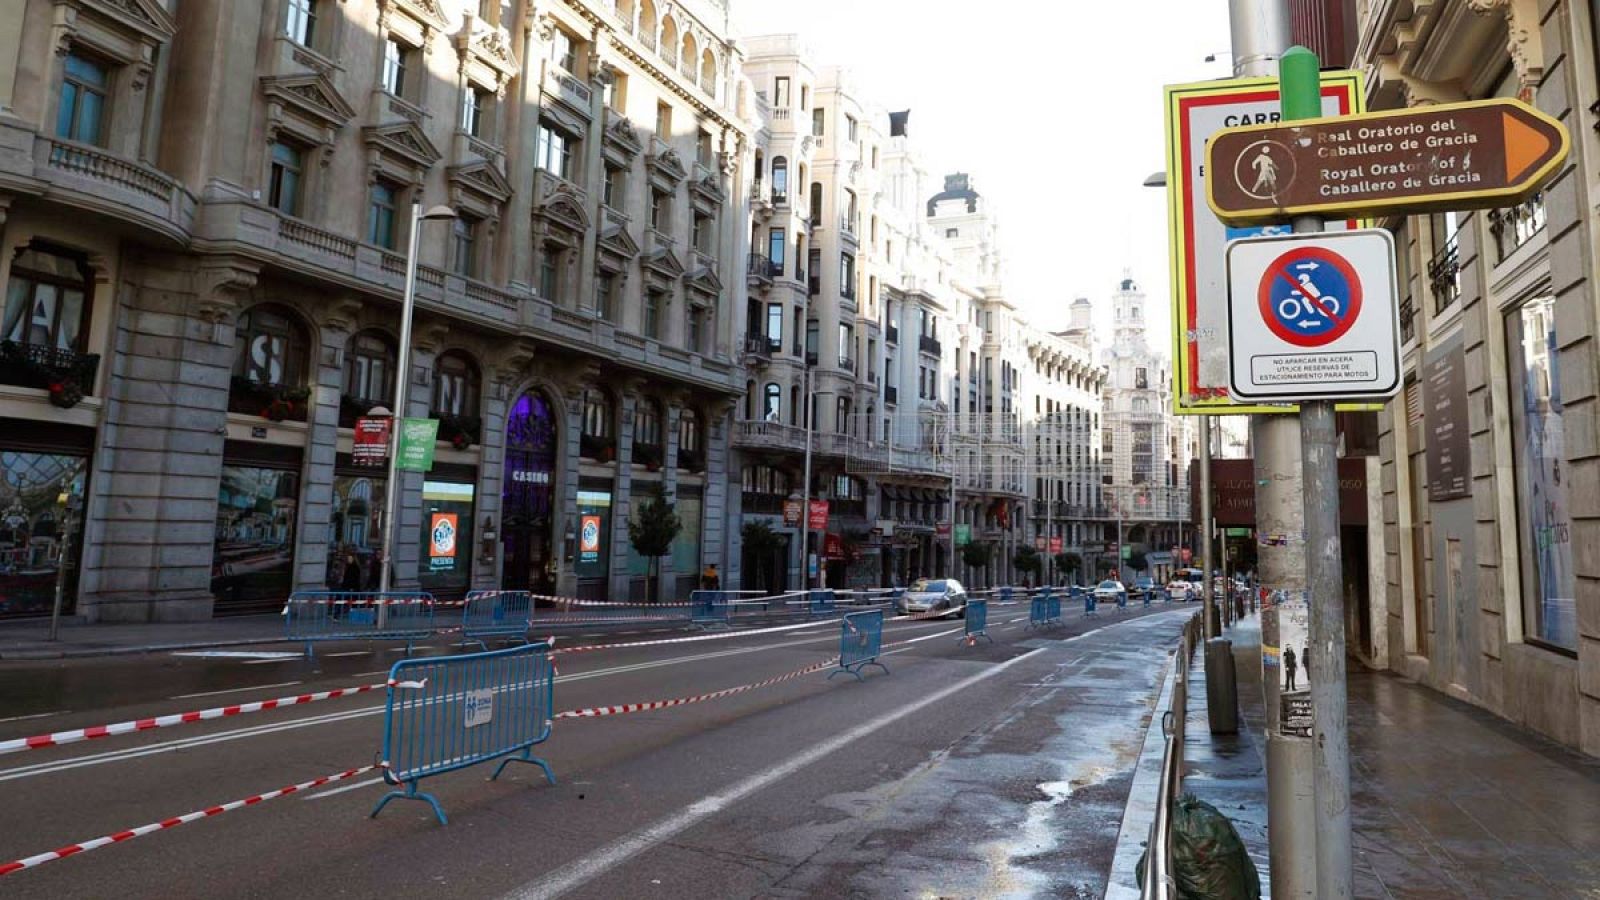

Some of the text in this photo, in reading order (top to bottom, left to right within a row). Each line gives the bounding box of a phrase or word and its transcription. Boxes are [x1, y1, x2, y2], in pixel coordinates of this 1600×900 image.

[1224, 112, 1281, 128] CARR
[1318, 119, 1456, 144] Real Oratorio del
[1318, 132, 1478, 158] Caballero de Gracia
[1320, 165, 1364, 182] Royal
[1439, 156, 1456, 169] of
[1320, 171, 1481, 196] Caballero de Gracia
[1259, 372, 1324, 381] ESTACIONAMIENTO
[512, 470, 549, 484] CASINO
